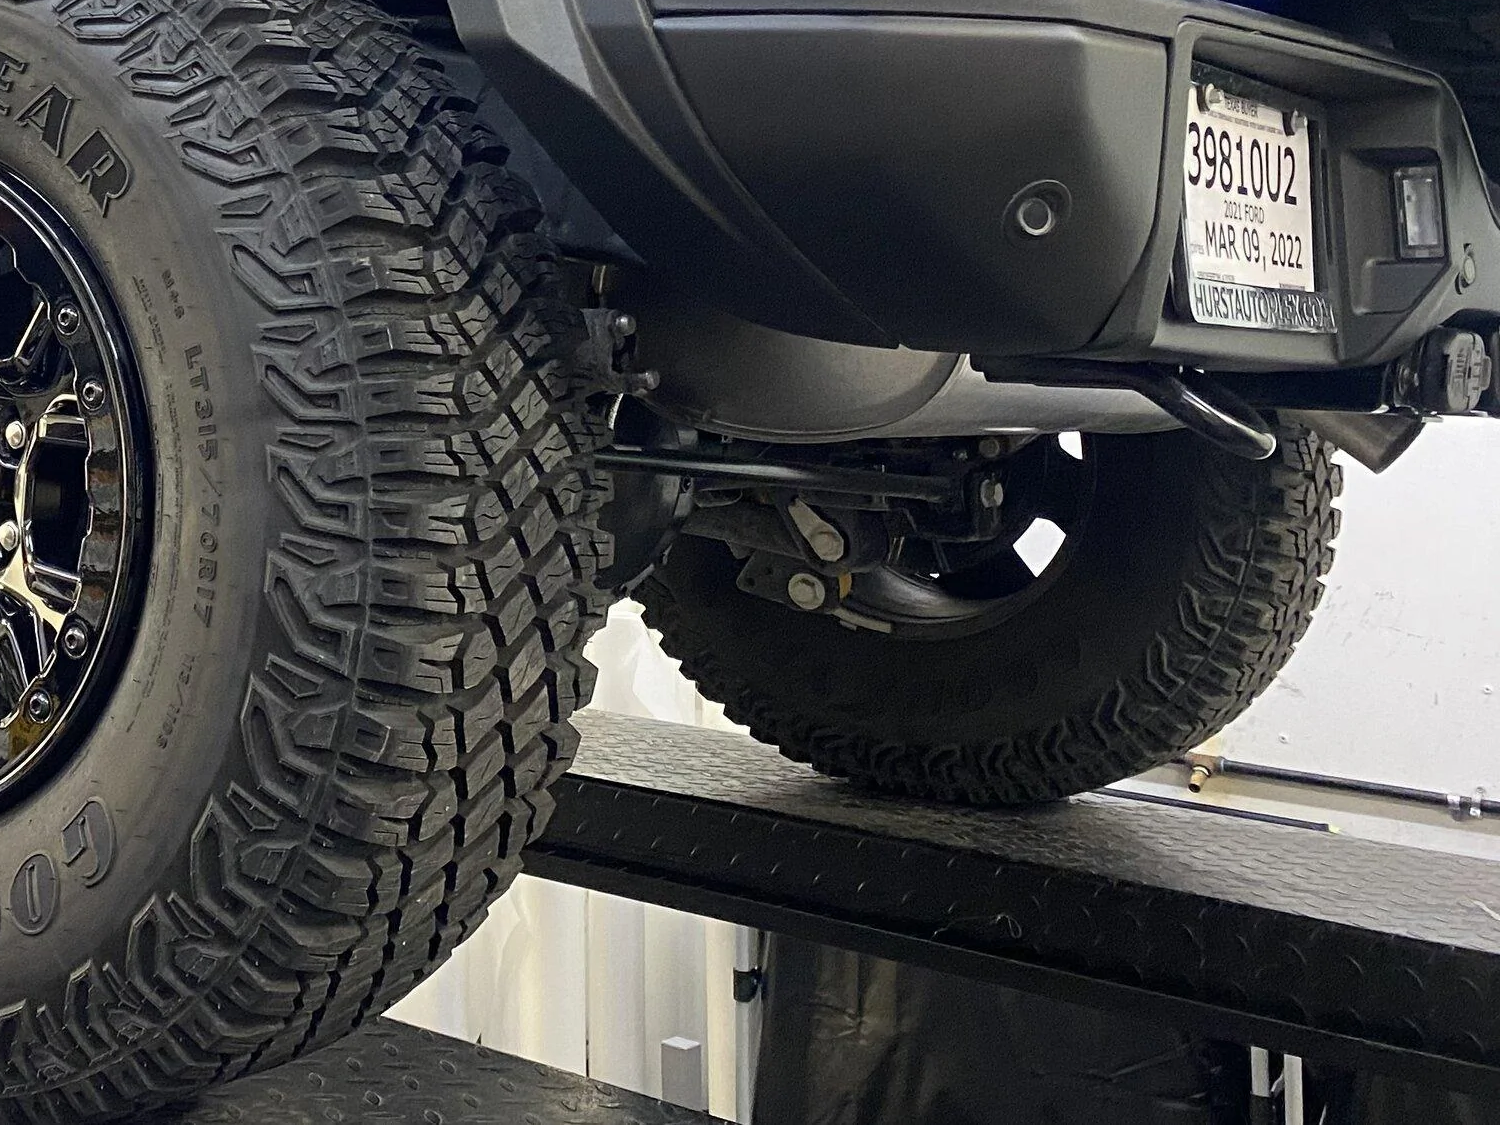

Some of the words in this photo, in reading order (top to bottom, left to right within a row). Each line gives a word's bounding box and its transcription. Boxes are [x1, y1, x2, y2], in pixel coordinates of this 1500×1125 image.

[1188, 122, 1298, 205] 39810U2
[1223, 200, 1242, 222] 2021
[1245, 203, 1265, 225] FORD
[1205, 220, 1240, 262] MAR
[1242, 226, 1267, 272] 09,
[1269, 231, 1303, 270] 2022
